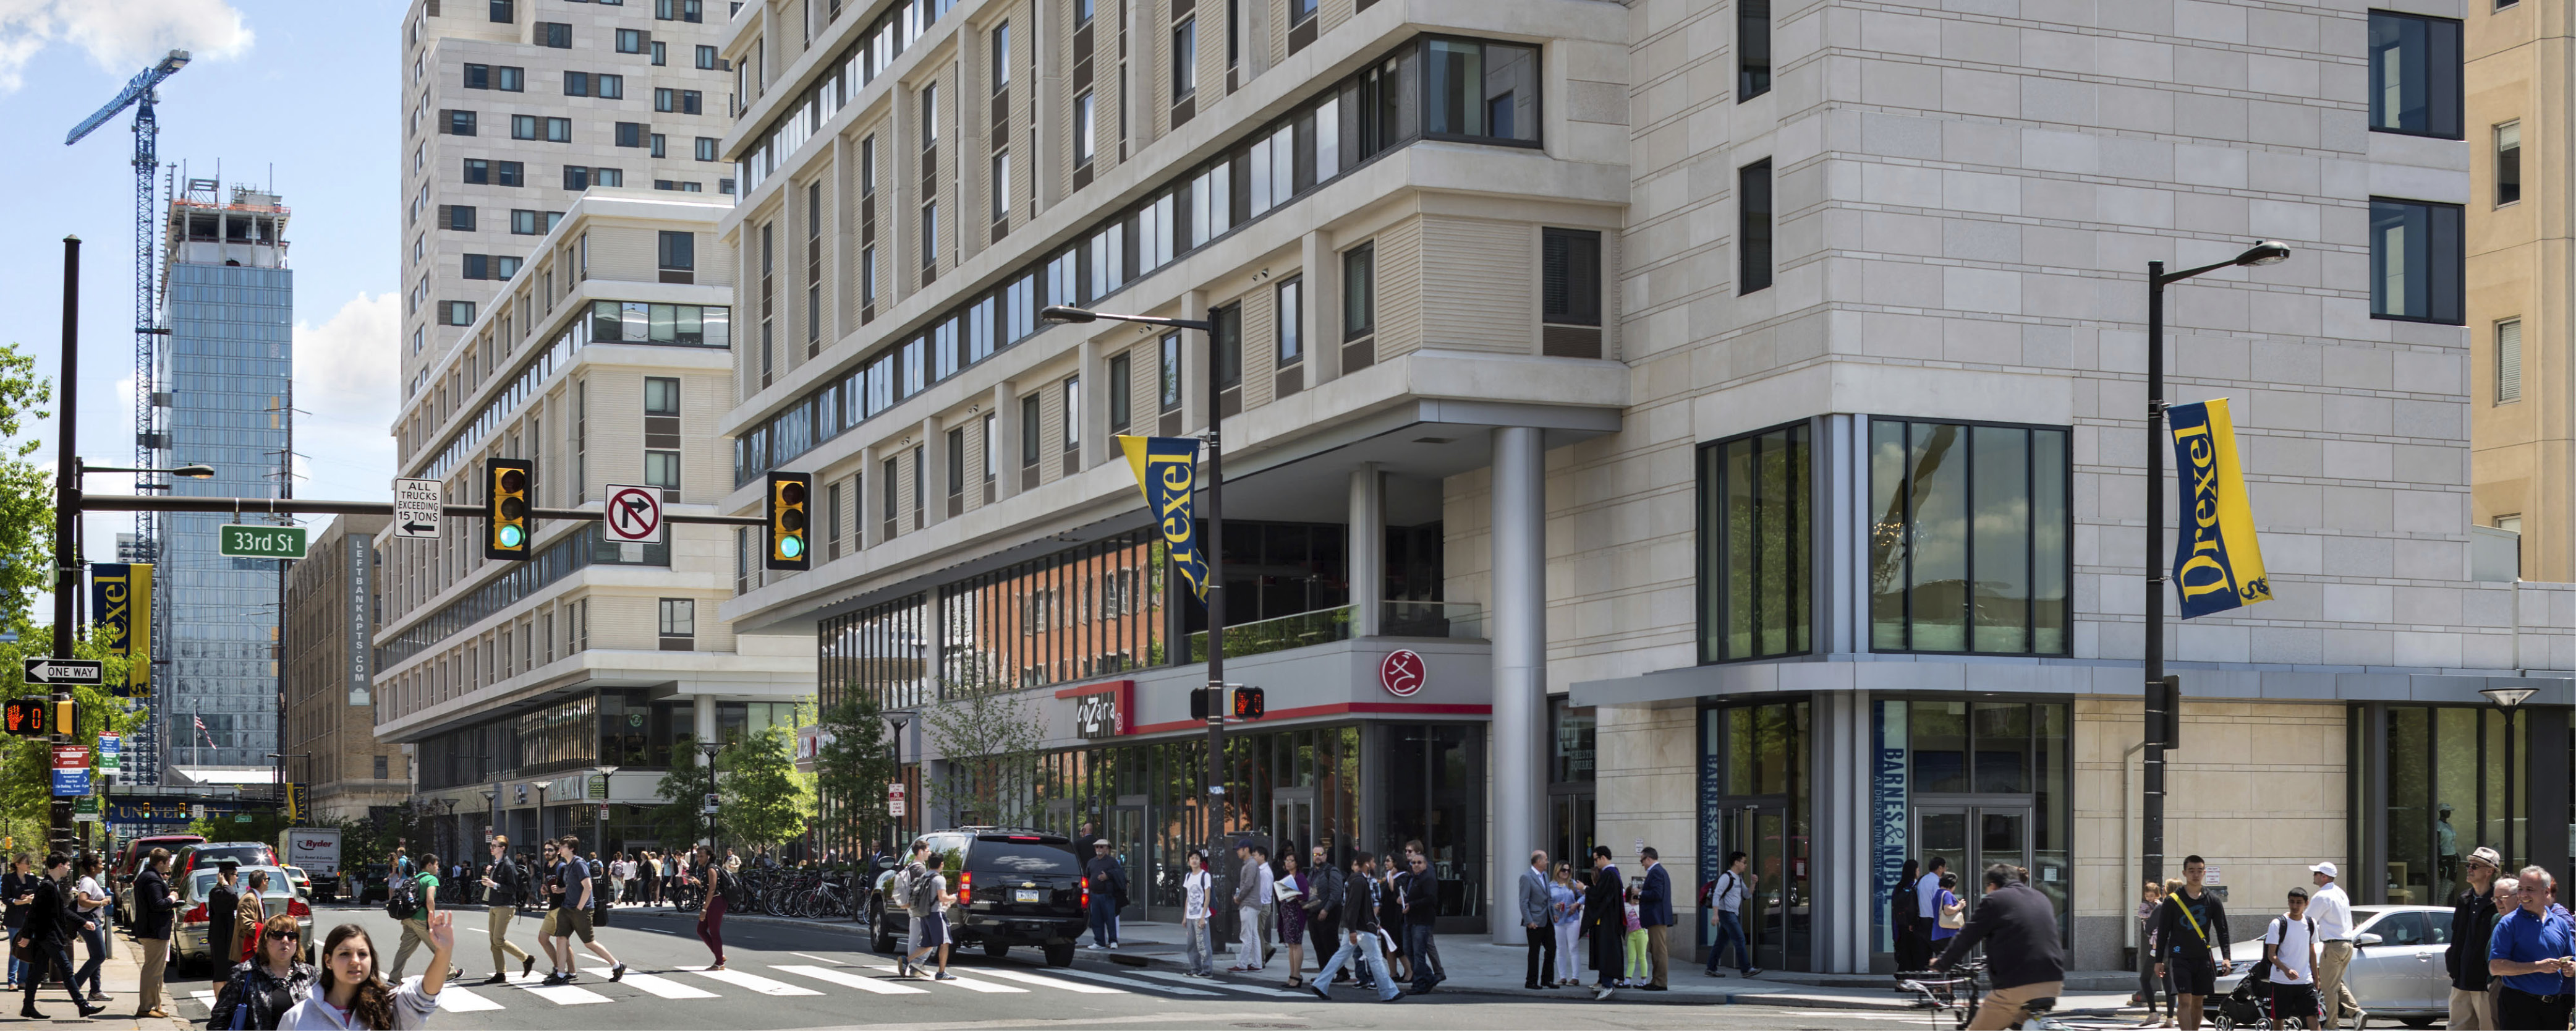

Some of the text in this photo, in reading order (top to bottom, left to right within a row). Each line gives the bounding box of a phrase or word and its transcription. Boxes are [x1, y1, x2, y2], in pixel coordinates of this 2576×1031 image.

[401, 491, 437, 500] TRUCKS
[408, 482, 431, 491] ALL
[397, 500, 438, 511] EXCEEDING
[2174, 420, 2231, 603] Drexel
[398, 511, 438, 522] 15 TONS
[1149, 451, 1198, 596] rexel
[234, 532, 294, 552] 33rd St
[355, 541, 364, 682] LEFTBANKAPTS.COM
[48, 667, 94, 677] ONE WAY
[1254, 694, 1262, 713] 0
[32, 708, 41, 729] 0
[293, 786, 306, 821] Drexel
[1874, 776, 1882, 877] AT DREXEL UNIVERSITY
[305, 839, 333, 849] Ryder
